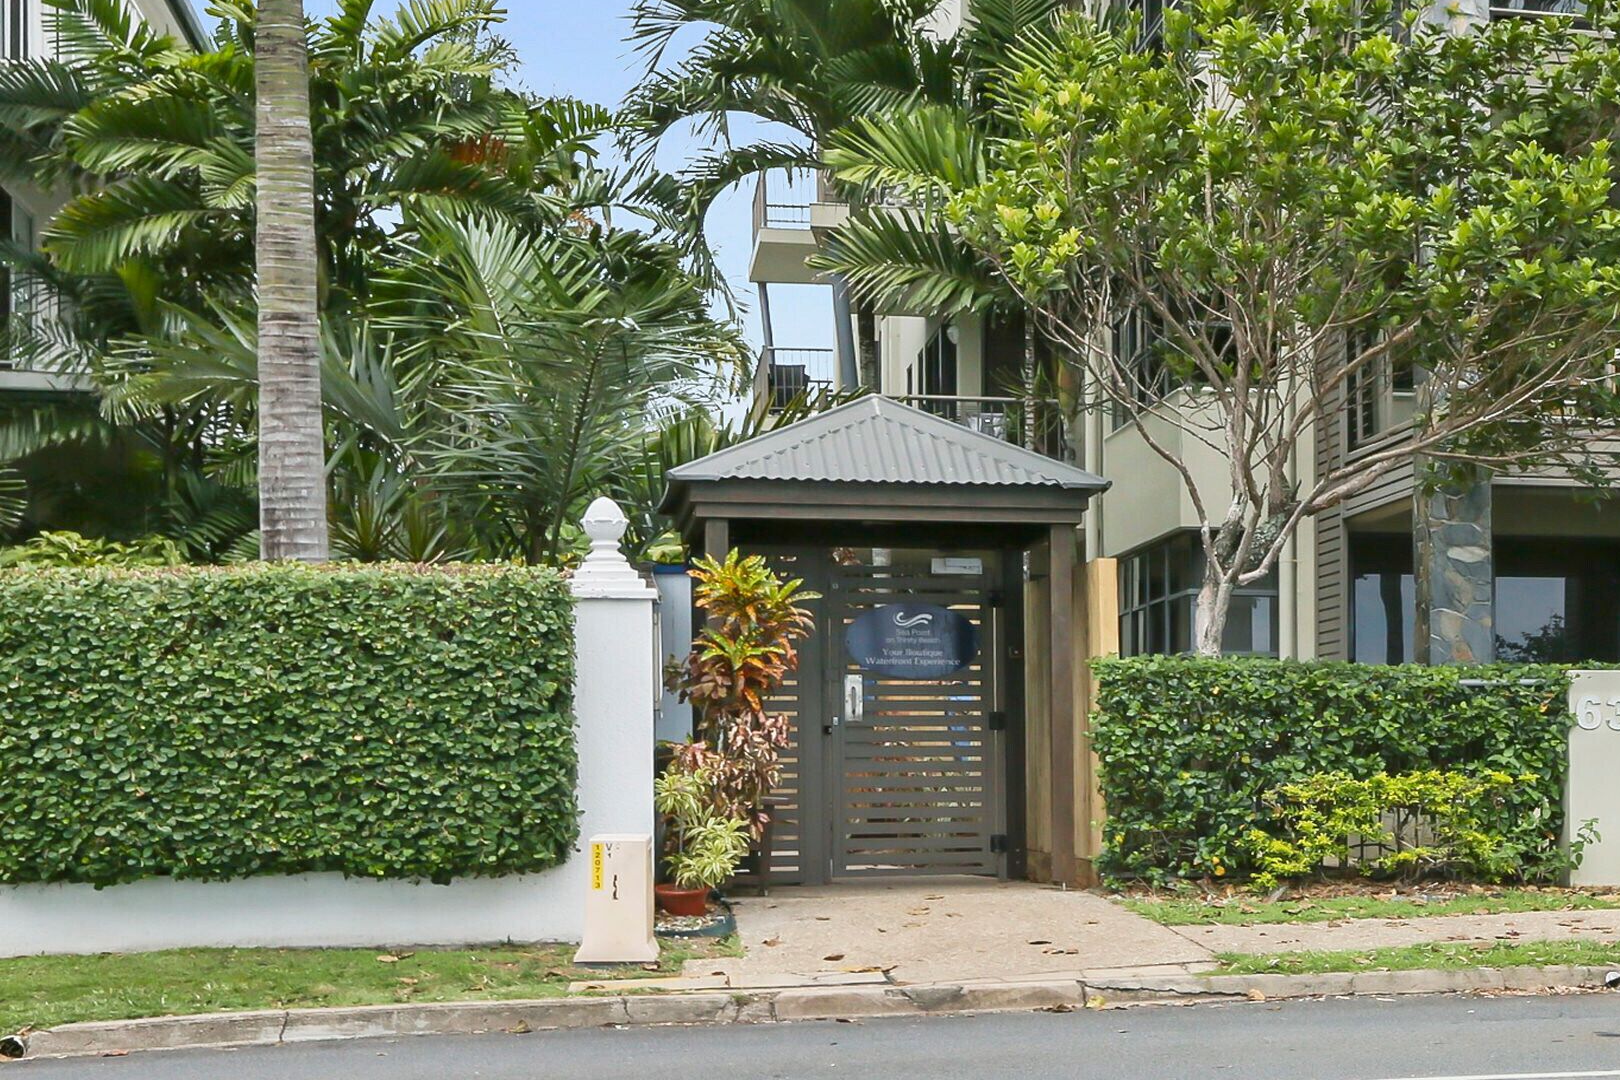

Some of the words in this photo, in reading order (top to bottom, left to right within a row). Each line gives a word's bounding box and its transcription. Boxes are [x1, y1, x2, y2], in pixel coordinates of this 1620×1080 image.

[882, 648, 903, 656] Your
[905, 648, 943, 657] Boutique
[865, 657, 914, 665] Waterfront
[914, 657, 961, 666] Experience
